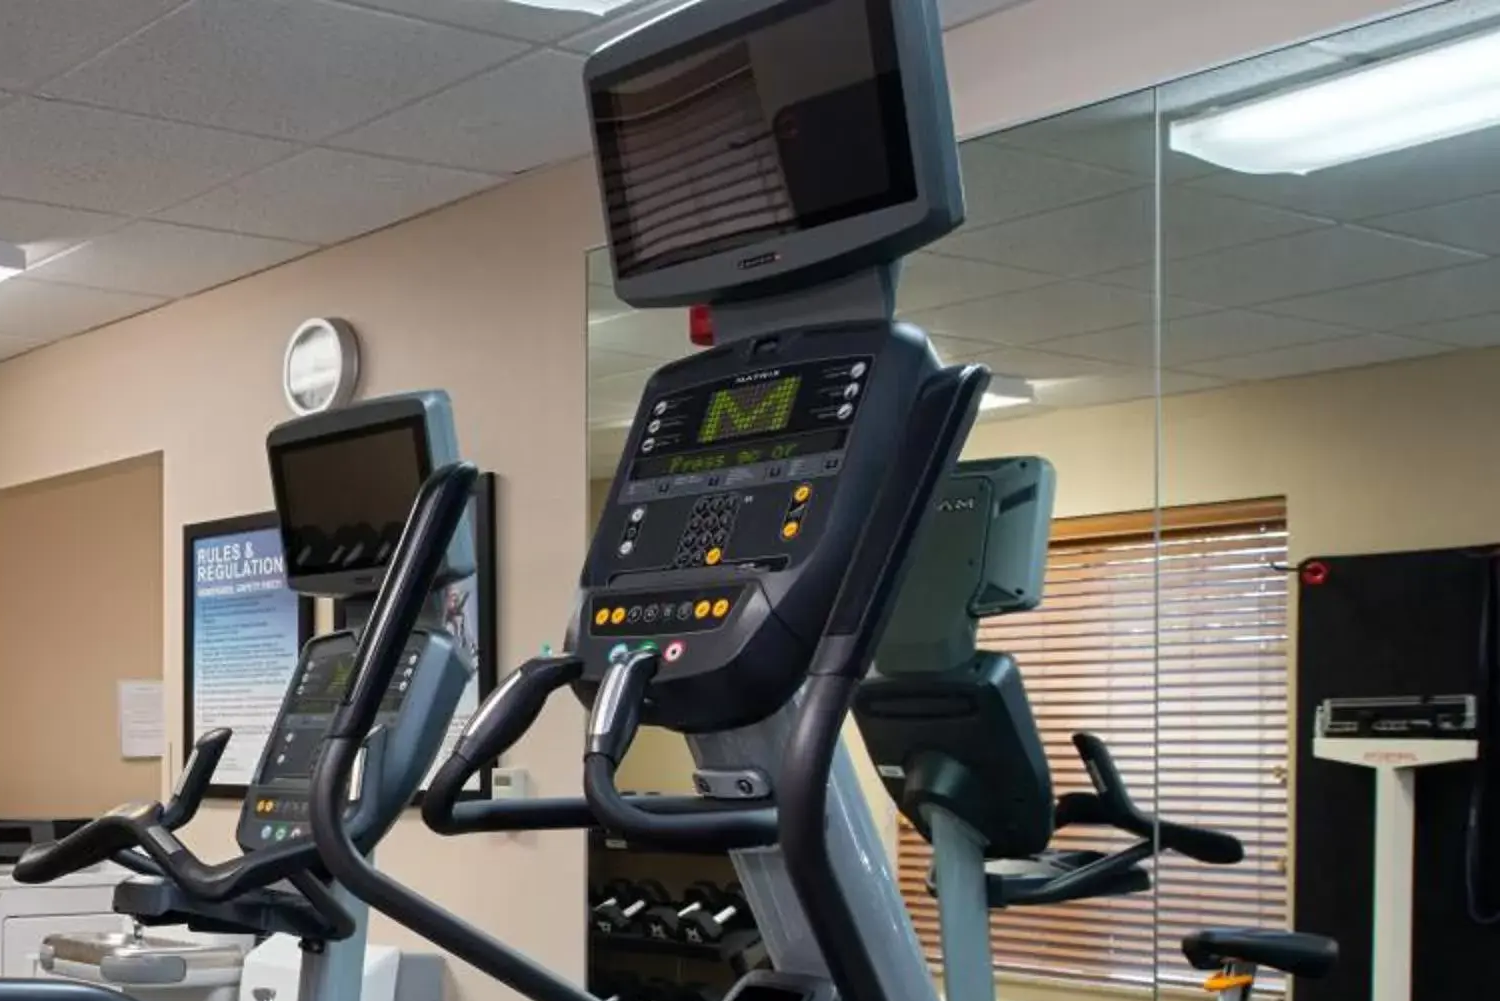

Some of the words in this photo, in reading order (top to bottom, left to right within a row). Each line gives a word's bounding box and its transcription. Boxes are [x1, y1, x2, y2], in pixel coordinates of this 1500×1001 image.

[700, 376, 801, 443] M
[197, 543, 241, 565] RULES
[244, 541, 254, 559] &
[197, 556, 284, 582] REGULATION
